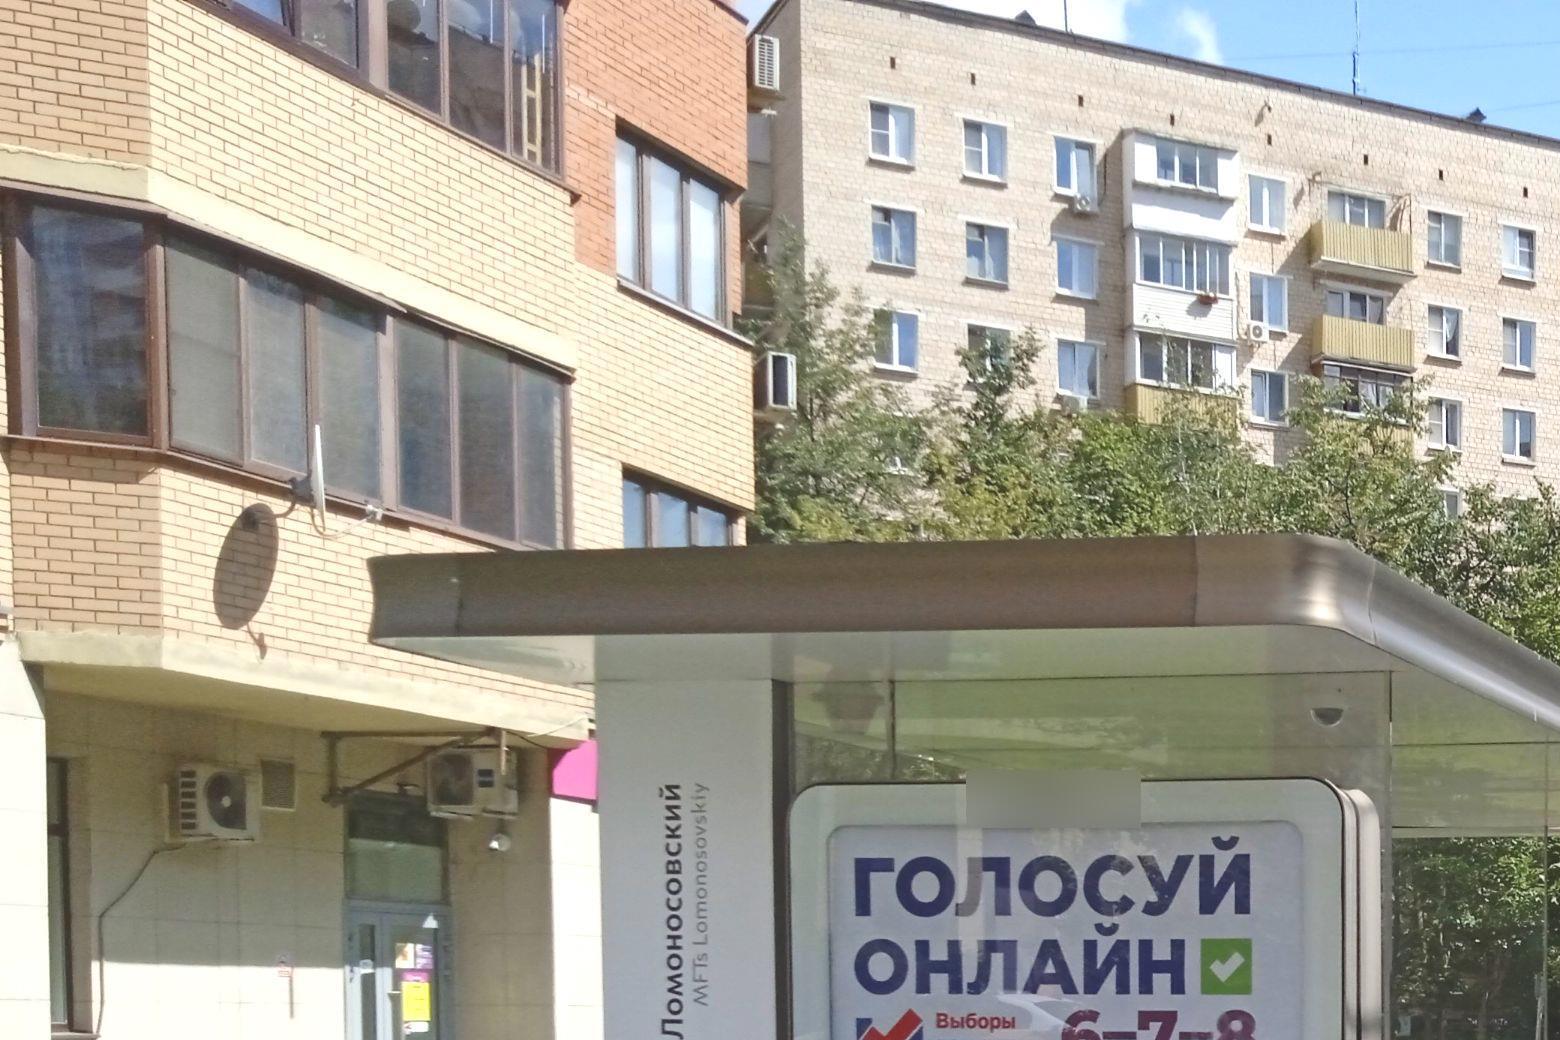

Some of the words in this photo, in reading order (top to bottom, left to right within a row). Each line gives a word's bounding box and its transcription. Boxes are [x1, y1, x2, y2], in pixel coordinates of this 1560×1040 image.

[691, 782, 710, 946] Lomonosovskiy
[854, 835, 1251, 917] ГОЛОСУЙ
[658, 784, 683, 1040] Ломоносовский
[692, 952, 708, 1007] MFTs
[854, 922, 1186, 995] ОНЛАЙН
[936, 1012, 1016, 1031] Выборы
